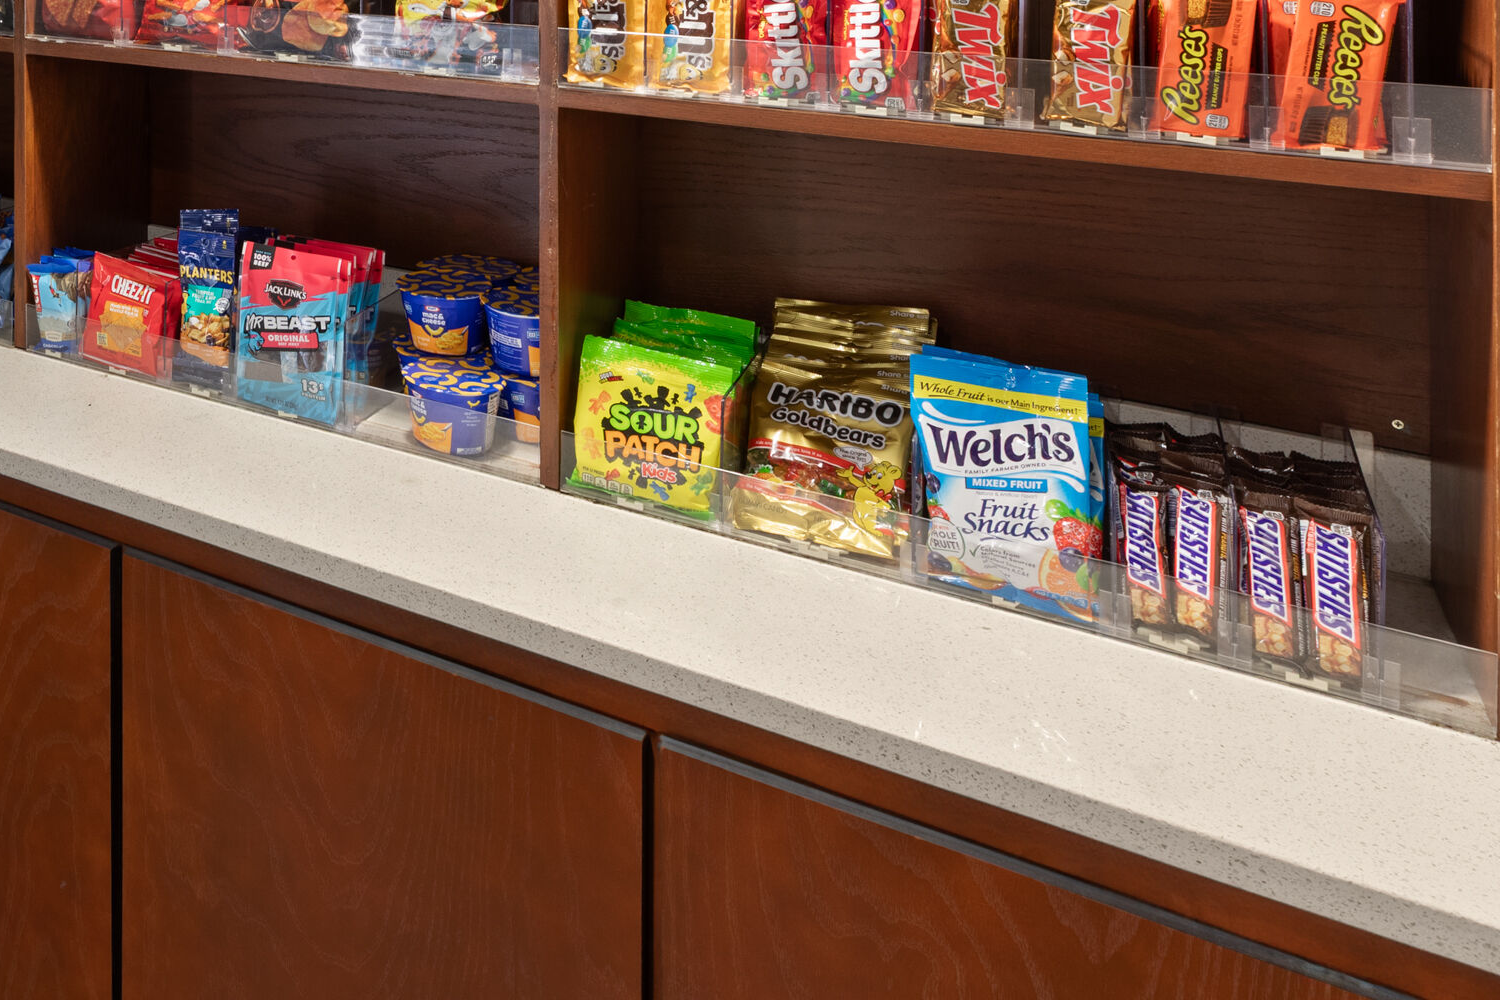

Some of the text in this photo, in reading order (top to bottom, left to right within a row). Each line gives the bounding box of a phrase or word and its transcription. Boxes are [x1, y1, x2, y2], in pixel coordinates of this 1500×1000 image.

[1322, 3, 1332, 16] 210
[1319, 29, 1328, 47] PEANUT
[952, 3, 1004, 109] Twix
[1070, 4, 1123, 114] Twix
[1216, 48, 1224, 62] CUPS
[1315, 48, 1324, 68] BUTTER
[1329, 5, 1384, 110] Reese's
[1162, 25, 1208, 126] Reese's
[1214, 63, 1222, 82] BUTTER
[1312, 69, 1321, 85] CUPS
[253, 252, 272, 263] 100%
[253, 259, 270, 268] BEEF
[179, 264, 234, 285] PLANTERS
[264, 283, 283, 296] JACK
[421, 311, 438, 319] mac
[421, 317, 446, 326] cheese
[890, 310, 915, 318] Share
[267, 334, 310, 343] ORIGINAL
[877, 370, 902, 378] Share
[768, 382, 904, 428] HARIBO
[920, 381, 955, 396] Whole
[956, 387, 986, 401] Fruit
[995, 397, 1010, 406] our
[1010, 399, 1031, 410] Main
[609, 403, 699, 445] SOUR
[770, 406, 886, 450] Goldbears
[604, 429, 701, 473] PATCH
[926, 421, 1076, 468] Welch's
[641, 461, 677, 483] Kids
[991, 465, 1019, 473] FARMER
[971, 478, 1043, 490] MIXED FRUIT
[978, 498, 1039, 521] Fruit
[961, 511, 1051, 542] Snacks
[1126, 487, 1161, 593] SATISFIES
[1178, 489, 1211, 596] SATISFIES
[1251, 515, 1288, 621] SATISFIES
[1315, 523, 1355, 642] SATISFIES
